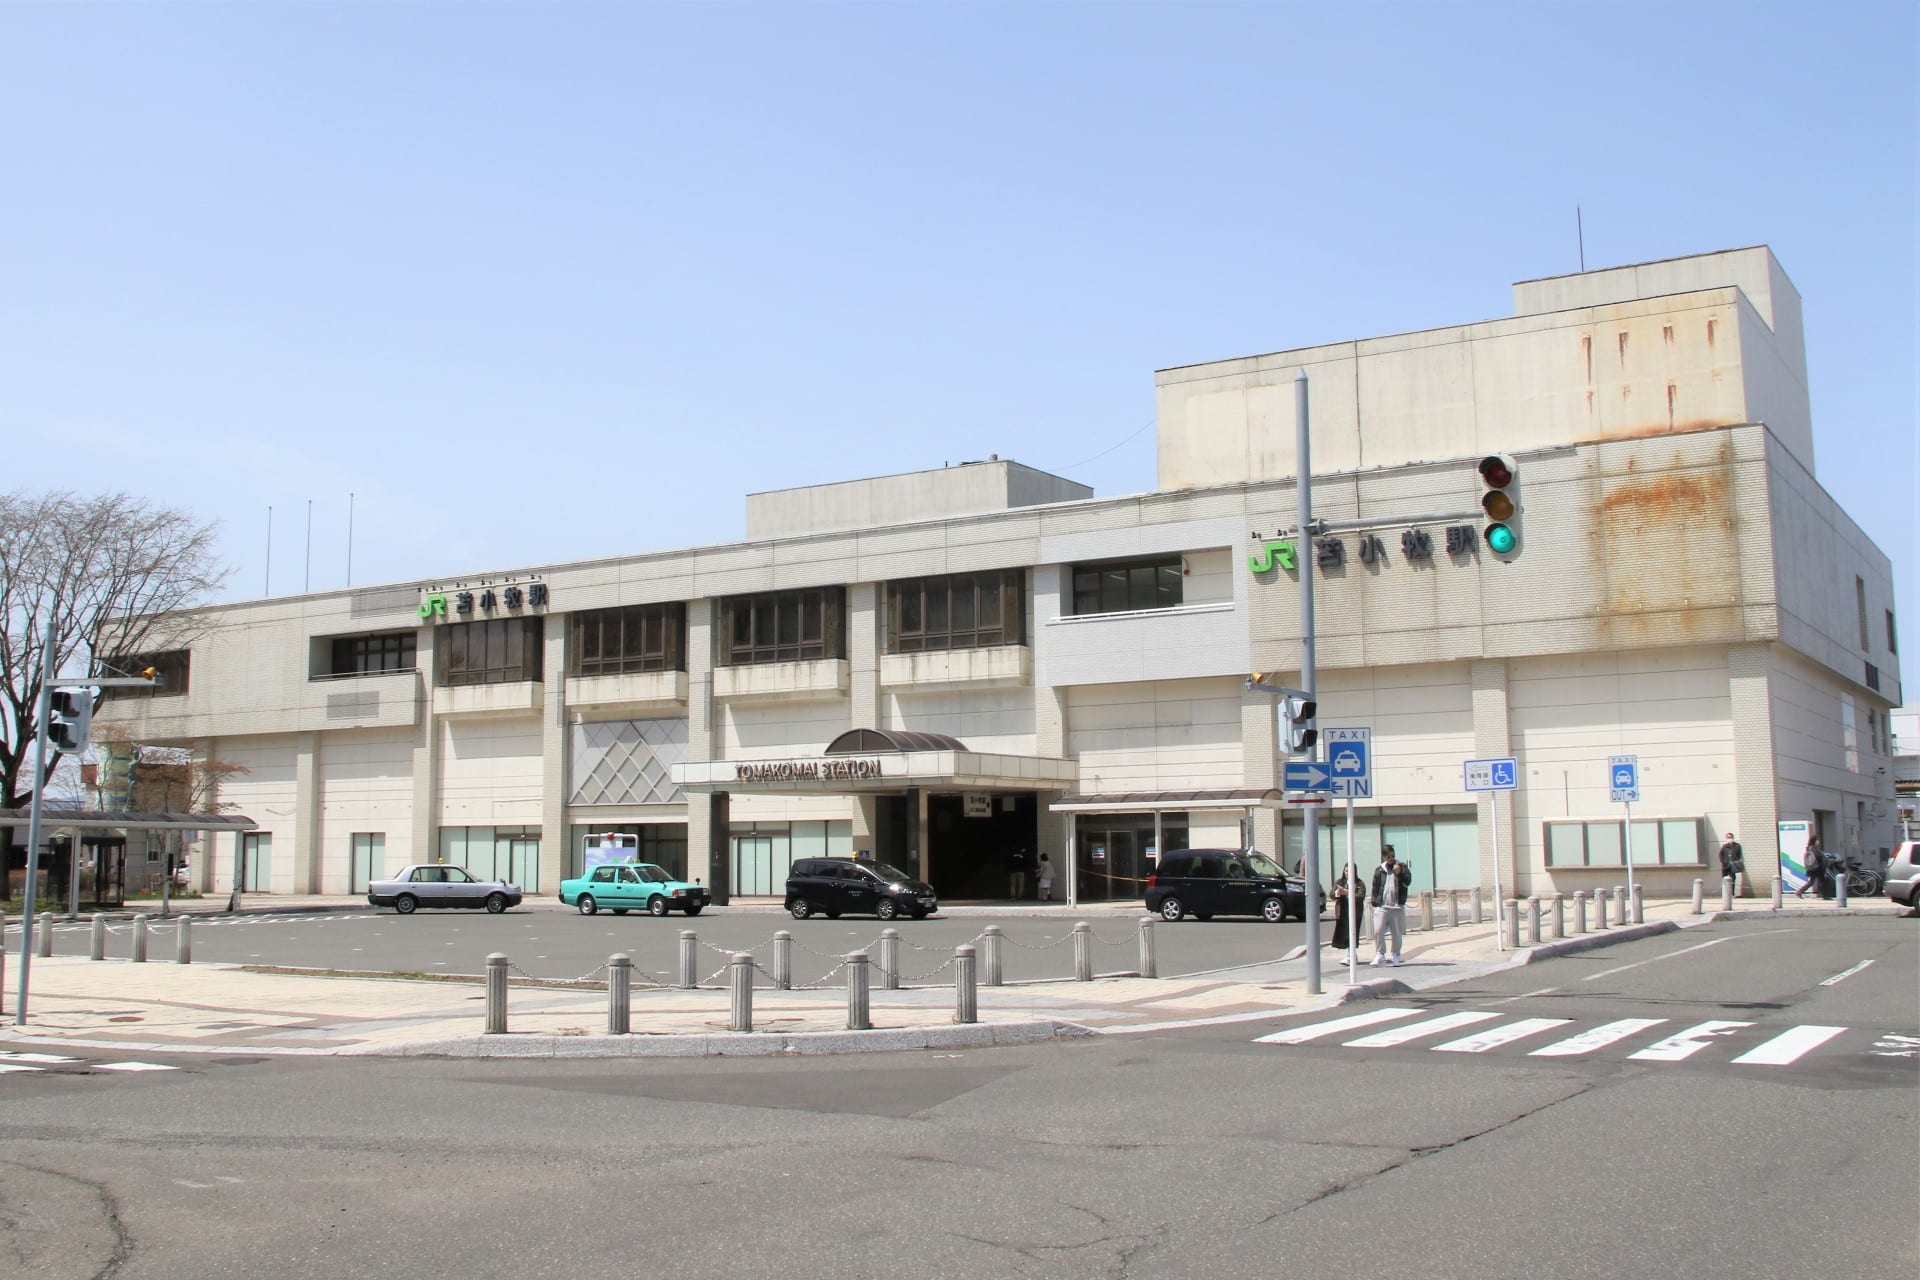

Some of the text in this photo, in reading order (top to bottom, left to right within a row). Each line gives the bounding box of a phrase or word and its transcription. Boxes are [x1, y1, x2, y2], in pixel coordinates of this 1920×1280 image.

[1249, 525, 1475, 573] JR 苫小牧駅
[417, 584, 547, 618] JR 苫小牧駅
[1328, 730, 1366, 740] TAXI
[735, 759, 882, 781] TOMAKOMAI STATION
[1346, 779, 1368, 796] IN
[1612, 789, 1626, 801] OUT
